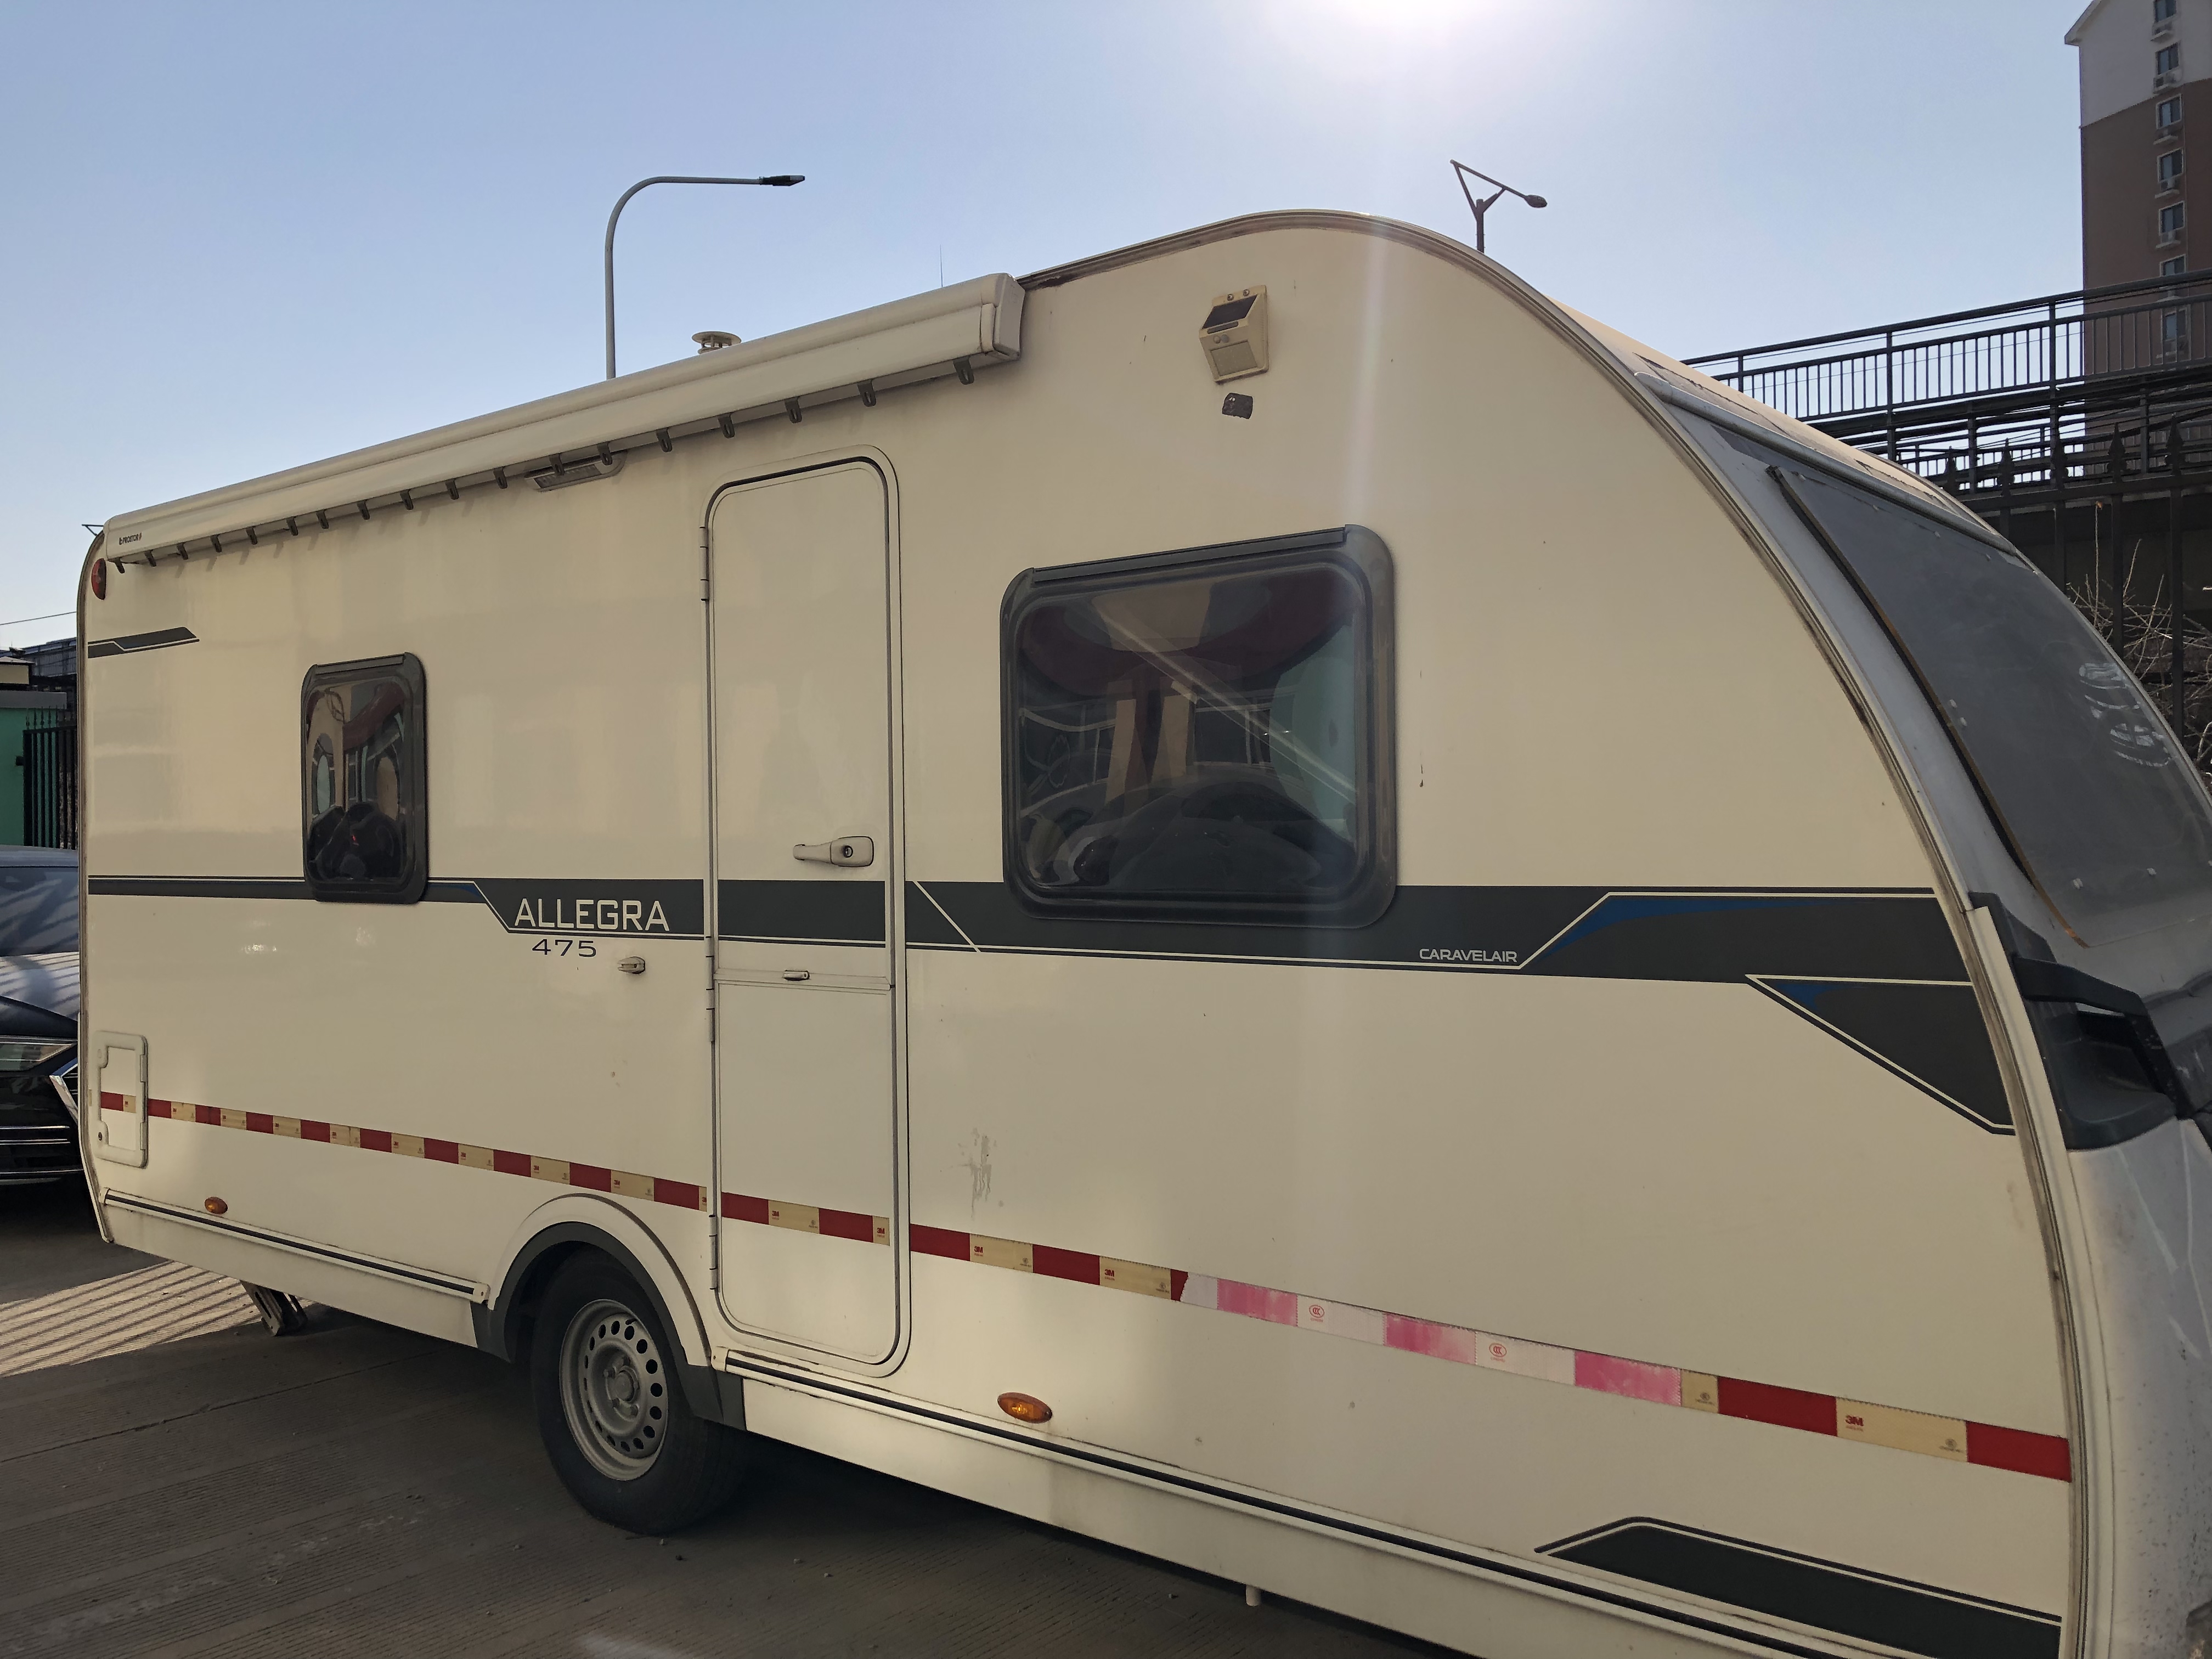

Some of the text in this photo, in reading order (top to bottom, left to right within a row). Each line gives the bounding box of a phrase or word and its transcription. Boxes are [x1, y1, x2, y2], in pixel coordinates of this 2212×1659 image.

[515, 898, 670, 932] ALLEGRA
[532, 938, 597, 957] 475
[1419, 948, 1518, 963] CARAVELAIR
[1845, 1415, 1864, 1426] 3M
